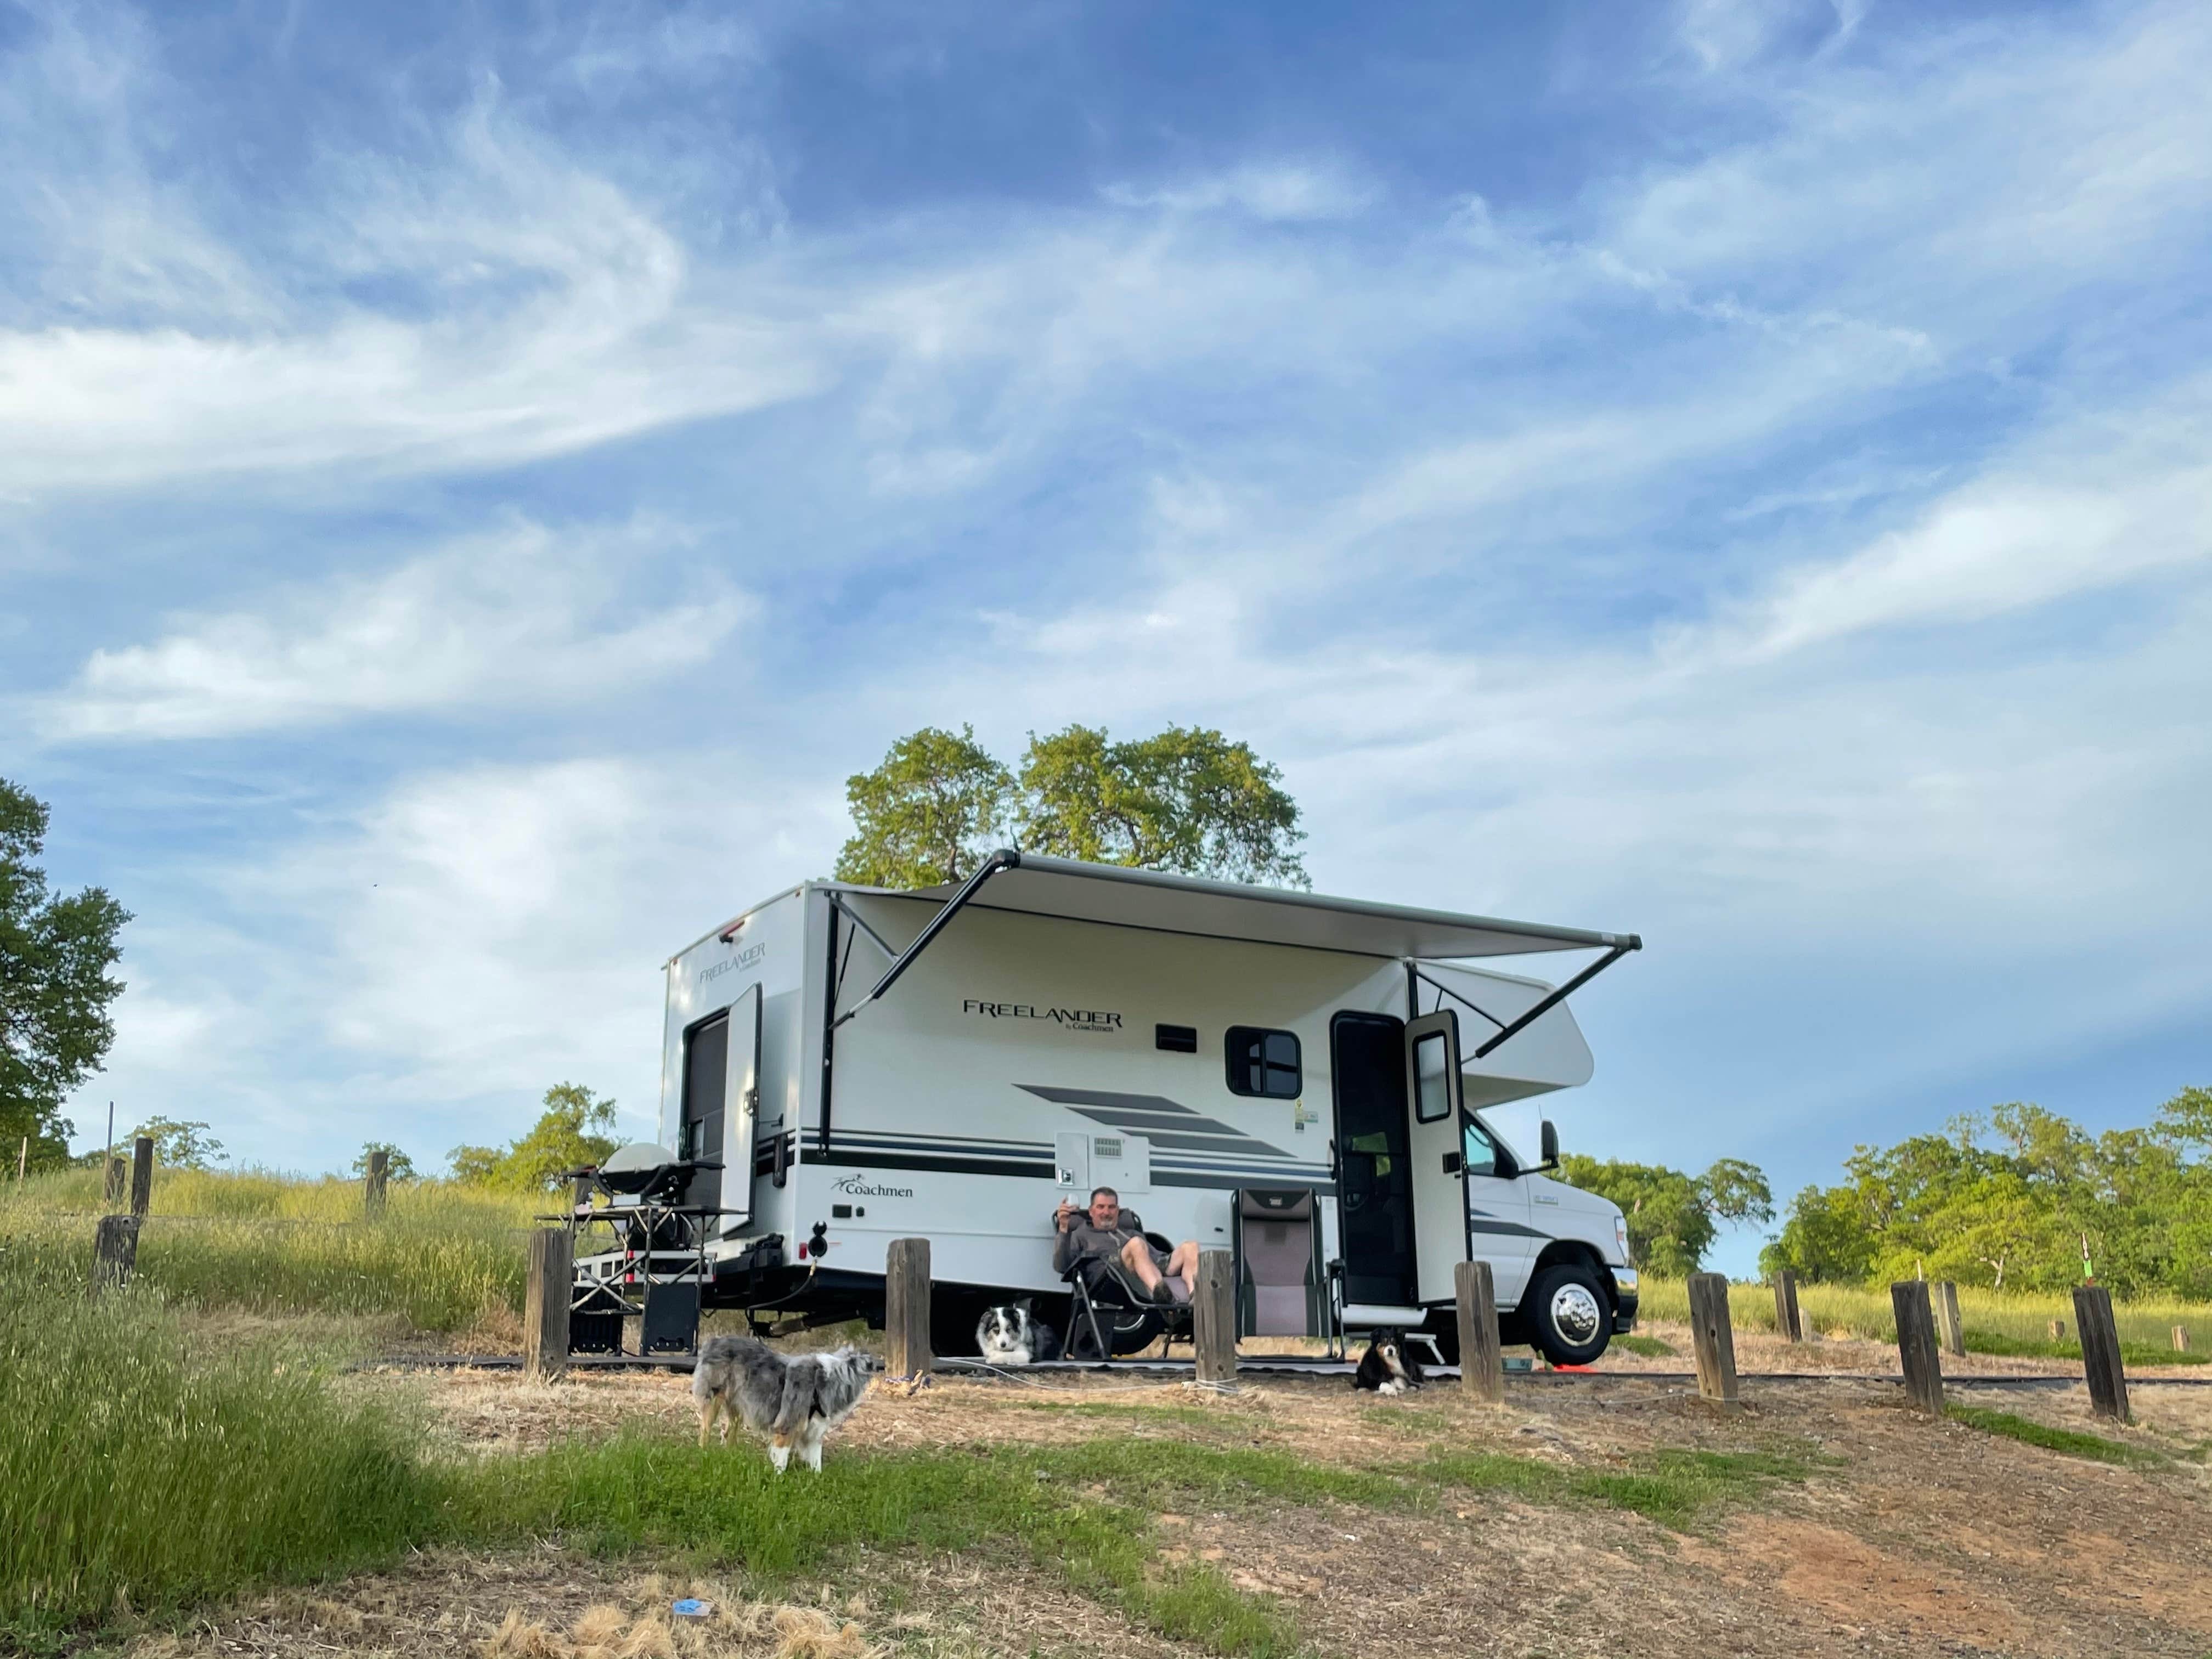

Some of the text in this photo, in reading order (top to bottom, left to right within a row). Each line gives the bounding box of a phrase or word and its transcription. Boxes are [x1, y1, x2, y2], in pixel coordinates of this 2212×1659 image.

[699, 942, 765, 984] FREELANDER
[963, 999, 1122, 1028] FREELANDER
[1072, 1022, 1114, 1032] Coachmen
[845, 1183, 913, 1198] Coachmen
